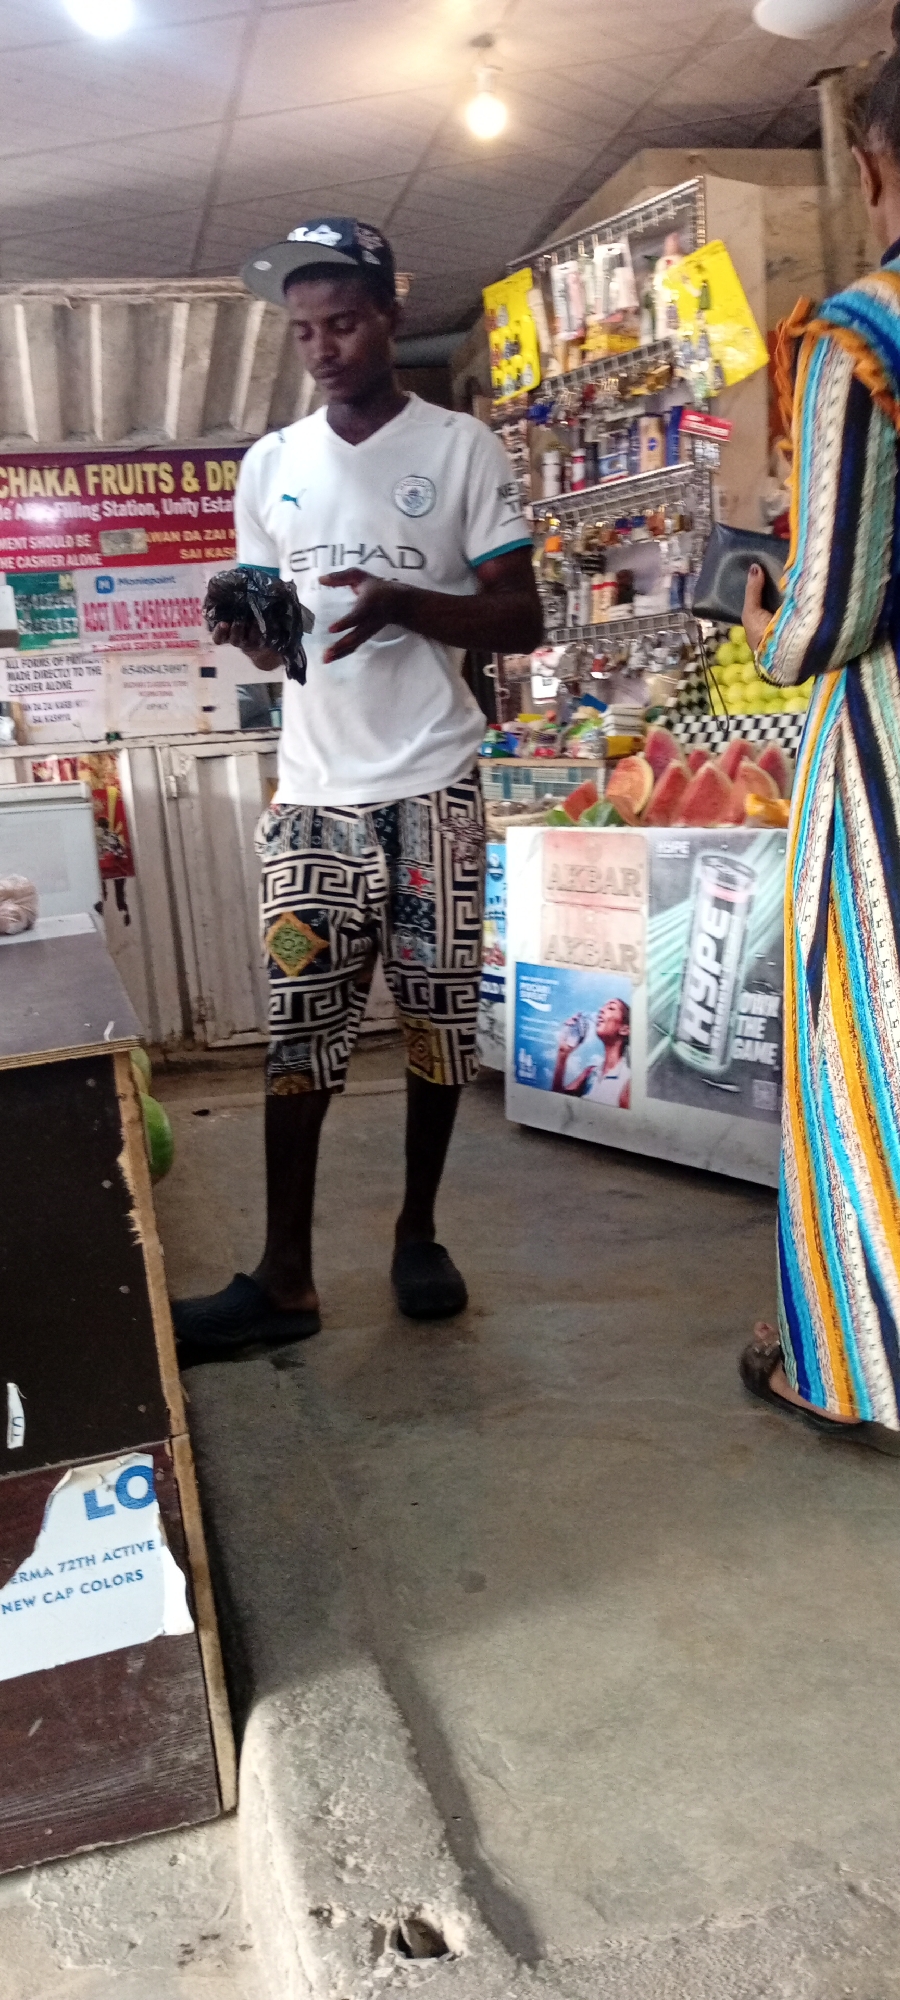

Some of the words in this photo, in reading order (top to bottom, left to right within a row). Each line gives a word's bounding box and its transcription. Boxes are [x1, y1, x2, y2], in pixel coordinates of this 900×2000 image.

[0, 466, 82, 499] CHAKA
[84, 461, 175, 497] FRUITS
[181, 460, 201, 493] &
[204, 459, 239, 492] DR
[101, 498, 160, 519] Station,
[160, 496, 200, 518] Unity
[200, 495, 235, 514] Esta
[28, 534, 75, 549] SHOULD
[75, 533, 92, 548] BE
[15, 553, 66, 569] CASHIER
[65, 551, 103, 567] ALONE
[289, 543, 427, 573] ETIHAD
[7, 671, 31, 681] MADE
[33, 668, 70, 680] DIRECTLY
[72, 667, 85, 677] TO
[85, 665, 102, 676] THE
[21, 658, 50, 668] FORMS
[51, 656, 64, 667] OF
[8, 682, 44, 693] CASHIER
[45, 680, 73, 691] ALONE
[682, 899, 732, 1046] HYPE
[735, 1014, 768, 1040] THE
[57, 1554, 97, 1573] 72TH
[101, 1539, 156, 1563] ACTIVE
[0, 1596, 37, 1615] NEW
[42, 1587, 74, 1604] CAP
[80, 1568, 145, 1594] COLORS
